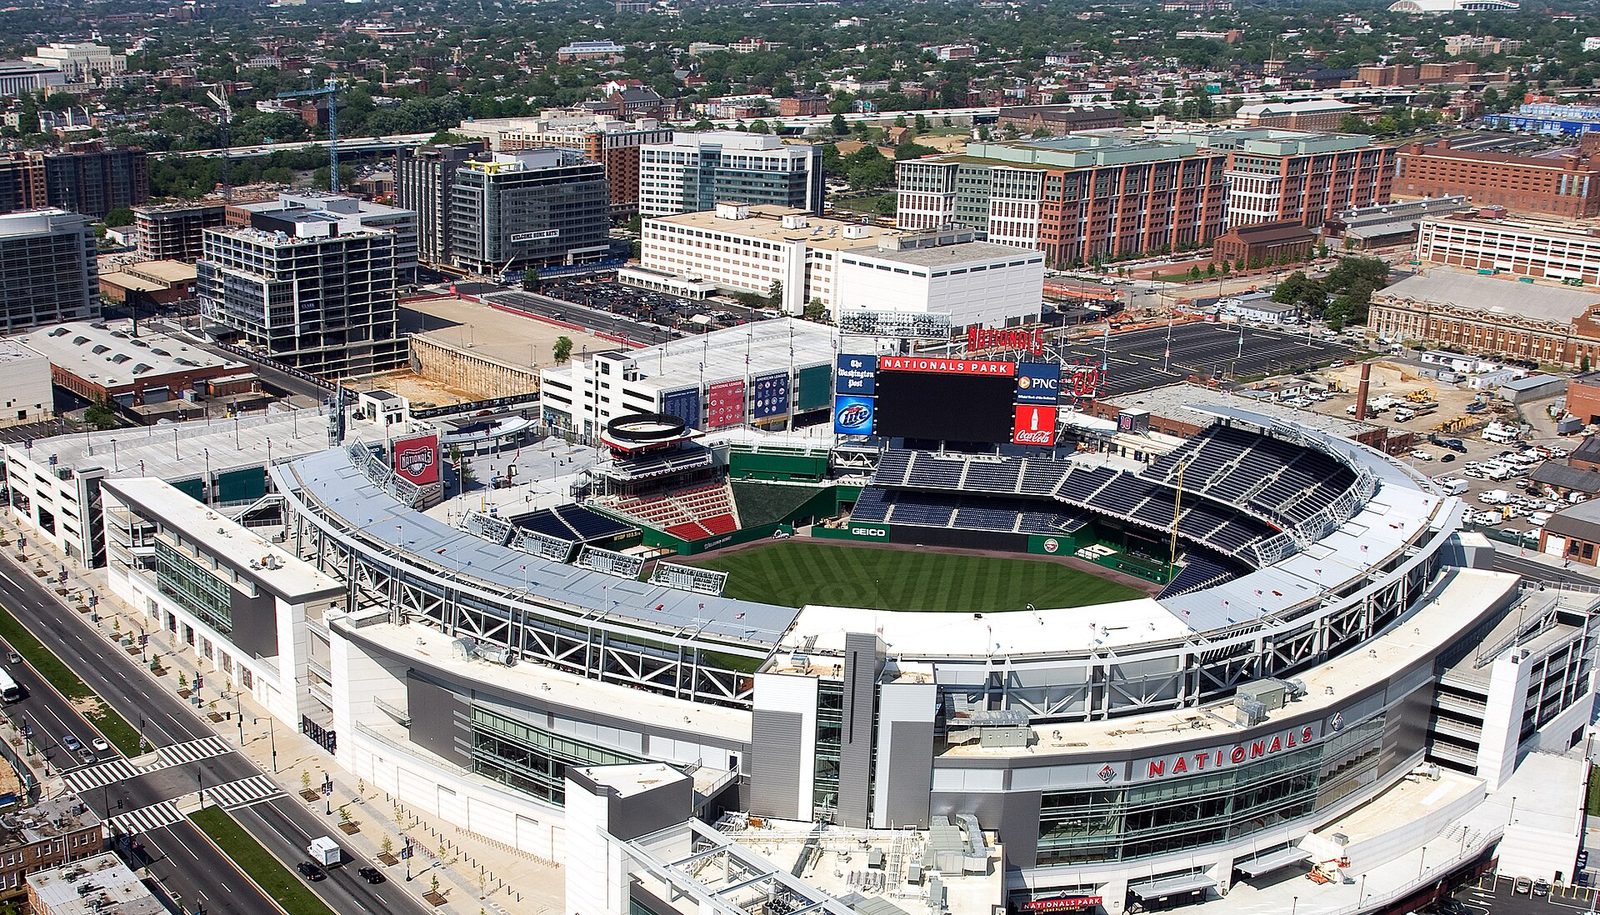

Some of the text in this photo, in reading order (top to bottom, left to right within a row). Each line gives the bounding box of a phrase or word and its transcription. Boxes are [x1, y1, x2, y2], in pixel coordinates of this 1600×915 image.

[512, 233, 533, 241] WELCOME
[968, 326, 1043, 356] NATIONALS
[850, 359, 863, 369] The
[884, 359, 1007, 373] NATIONALS PARK
[838, 368, 874, 379] Washington
[848, 379, 863, 389] Post
[1032, 377, 1057, 389] PNC
[1016, 429, 1053, 443] Coca-Cola
[401, 451, 432, 469] NATIONALS
[852, 527, 886, 537] GEICO
[1148, 726, 1313, 778] NATIONALS
[1024, 899, 1075, 910] NATIONALS
